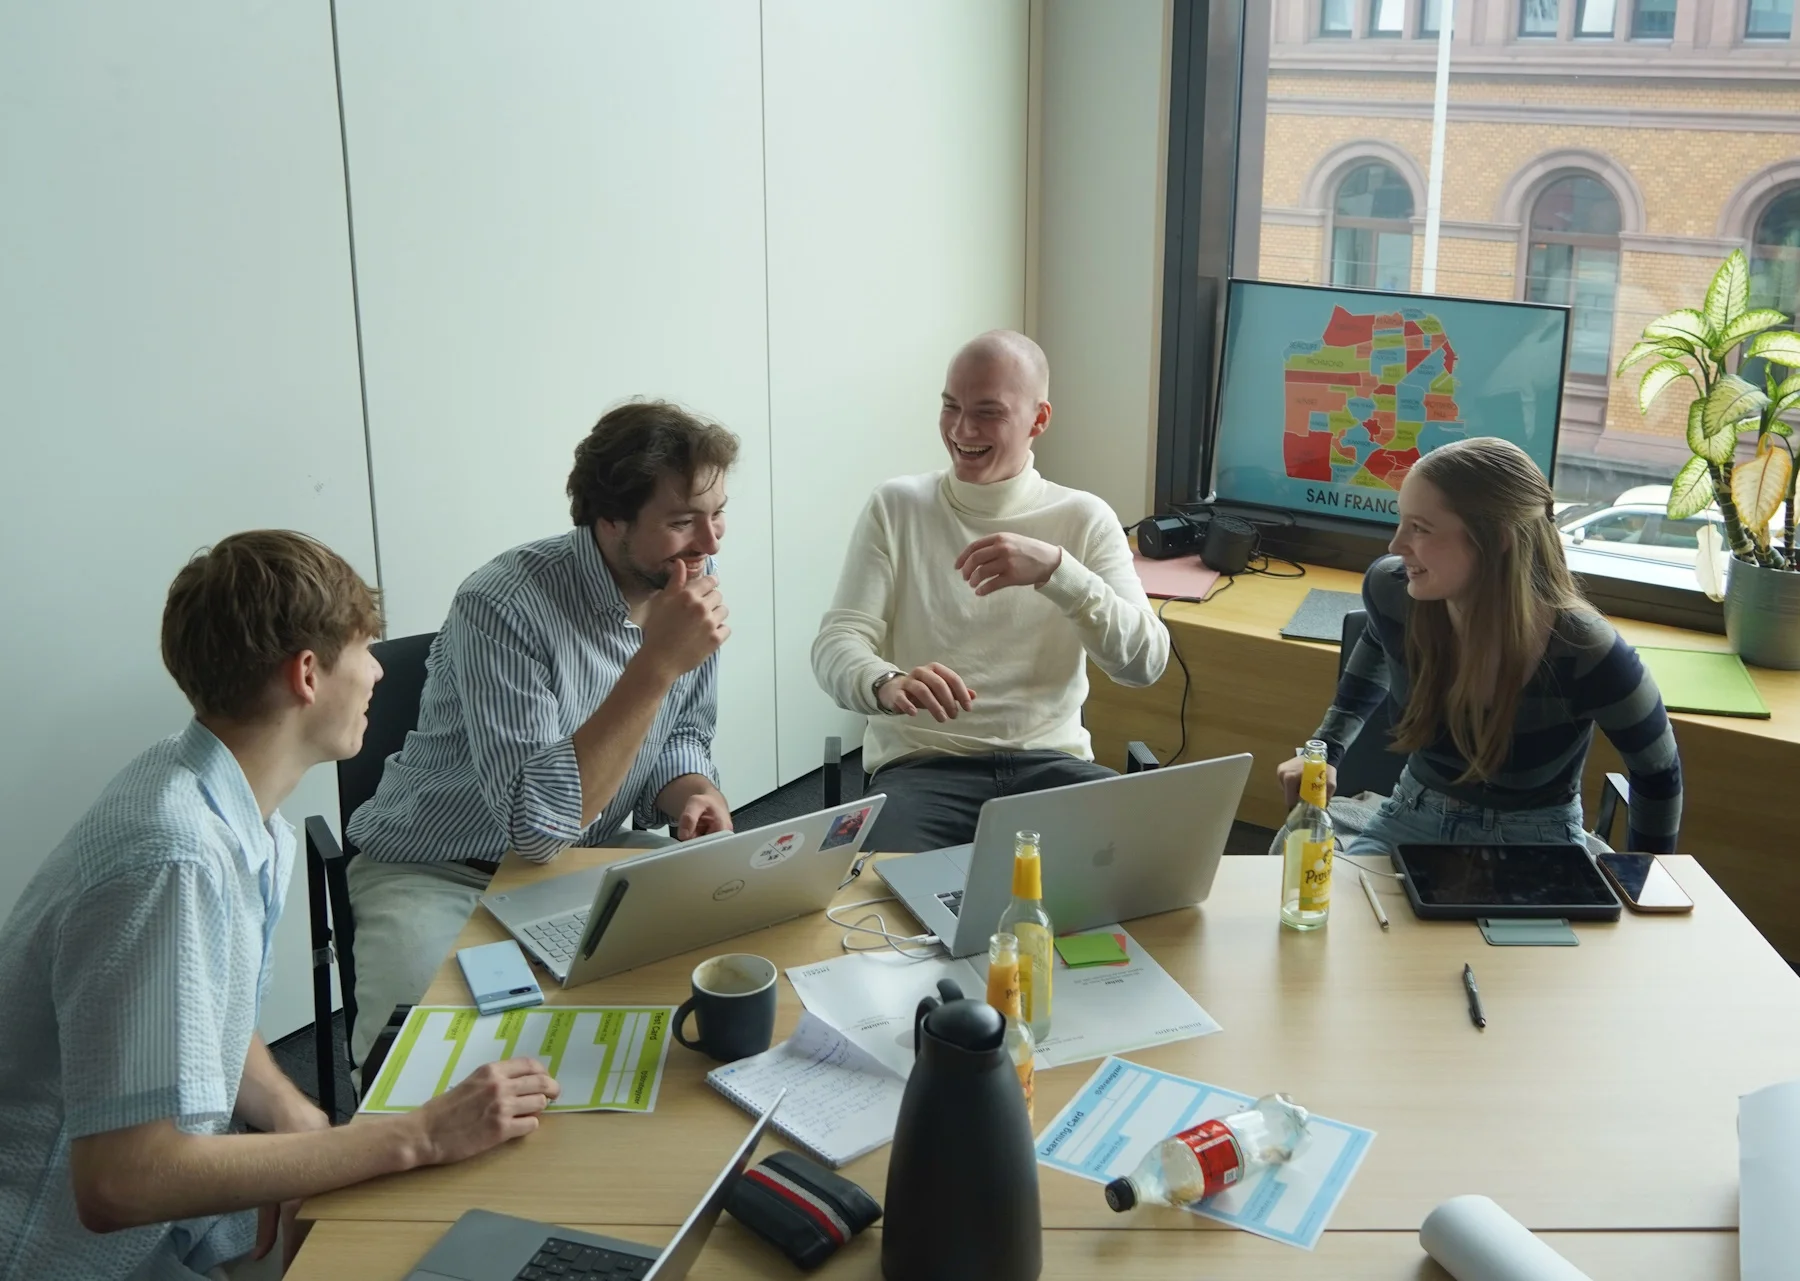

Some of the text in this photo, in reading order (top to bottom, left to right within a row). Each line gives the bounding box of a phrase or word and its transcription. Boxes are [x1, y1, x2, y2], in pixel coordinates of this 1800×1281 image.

[1306, 357, 1344, 368] RICHMOND
[1306, 488, 1339, 506] SAN
[649, 1012, 664, 1041] Test Card
[1040, 1110, 1085, 1157] Learning Card
